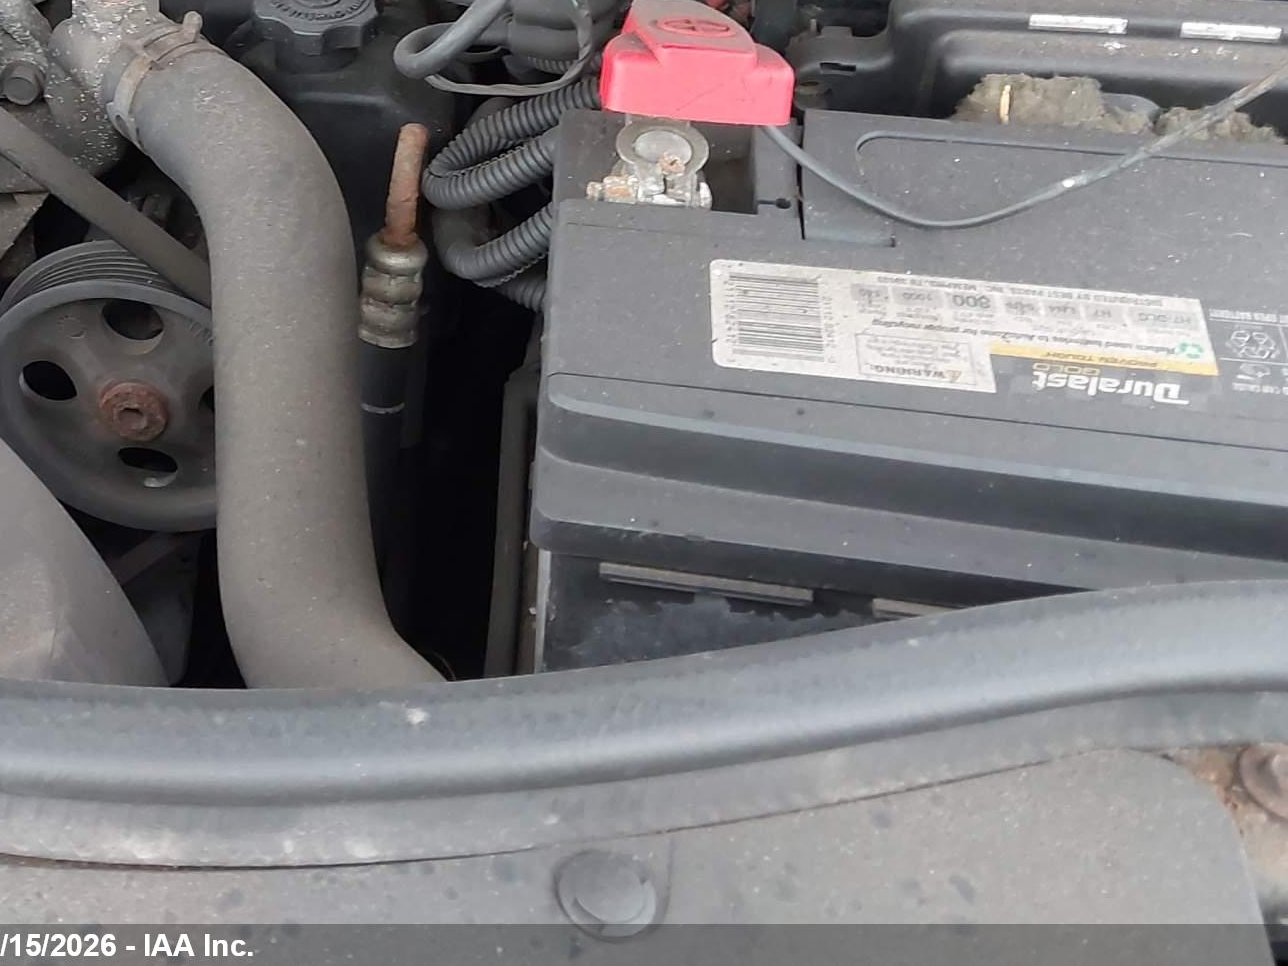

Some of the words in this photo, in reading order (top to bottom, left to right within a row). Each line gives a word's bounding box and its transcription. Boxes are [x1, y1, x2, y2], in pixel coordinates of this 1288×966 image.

[951, 295, 991, 310] 800
[1037, 335, 1049, 343] to
[1032, 362, 1100, 375] GOLD
[1100, 356, 1158, 369] PROVEN
[868, 364, 945, 380] WARNING:
[1032, 371, 1189, 405] Duralast
